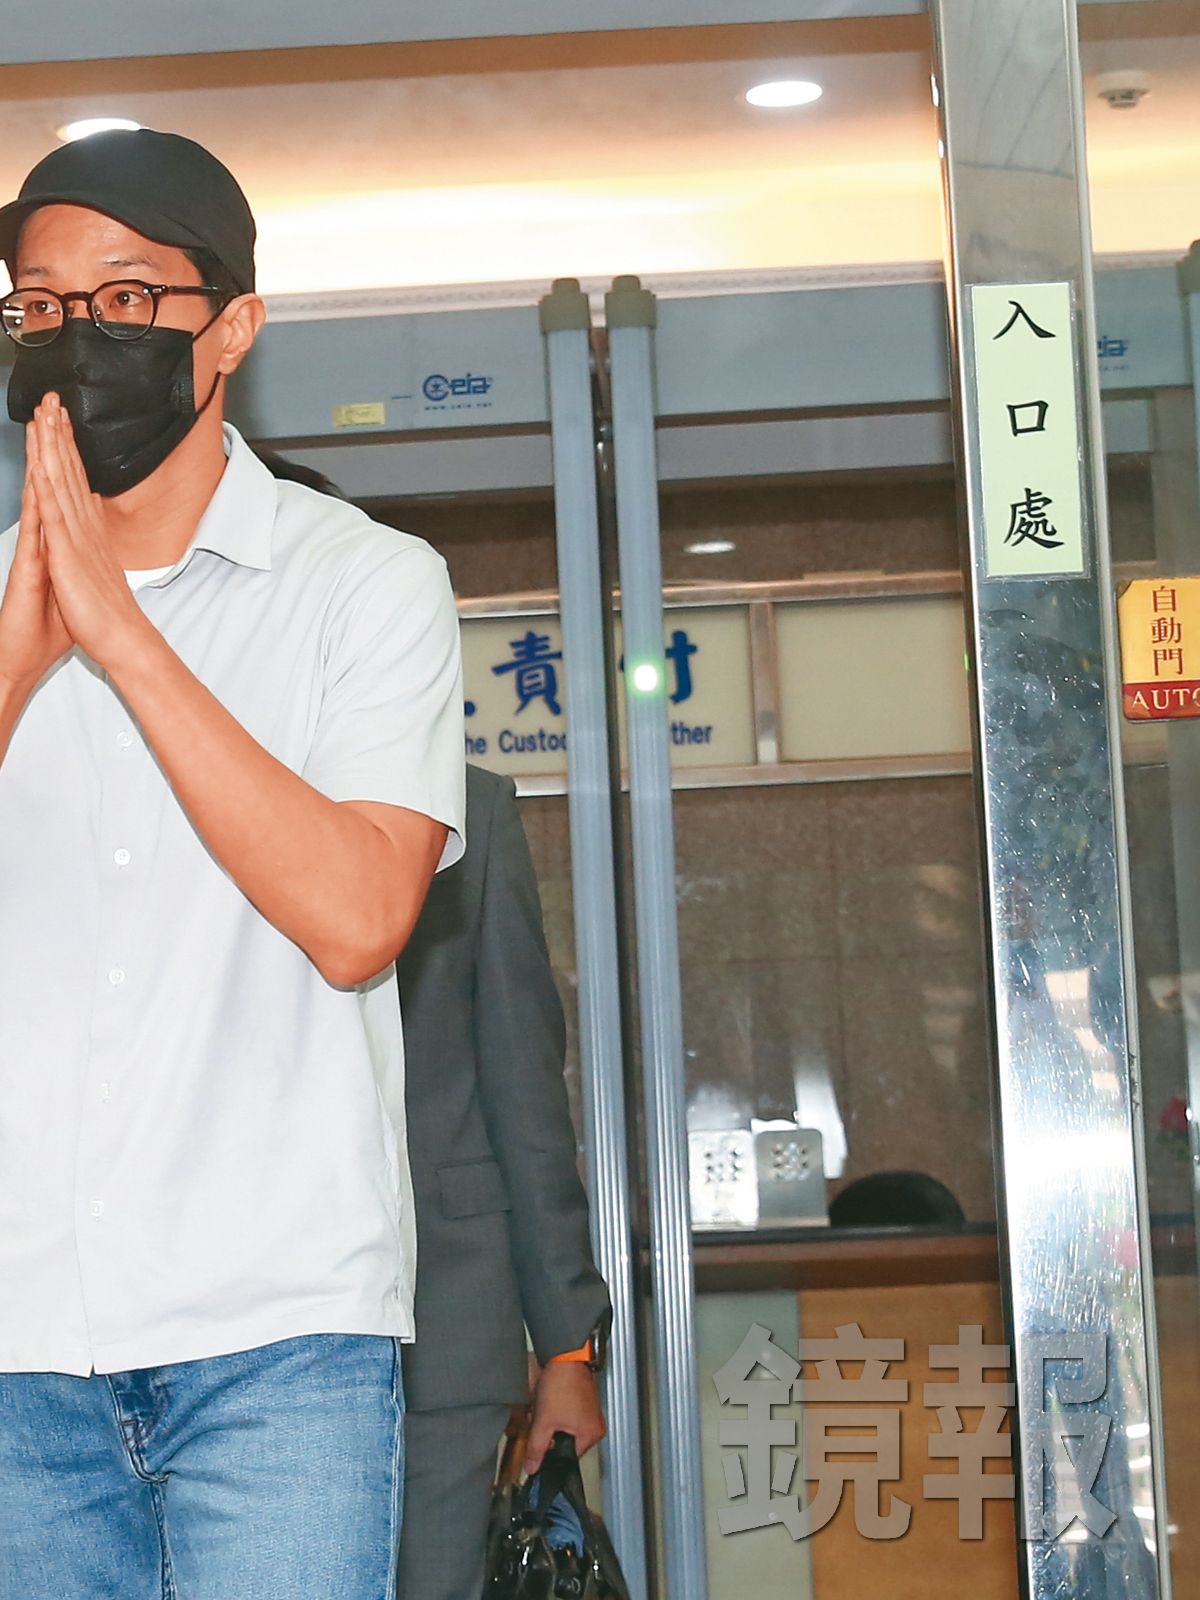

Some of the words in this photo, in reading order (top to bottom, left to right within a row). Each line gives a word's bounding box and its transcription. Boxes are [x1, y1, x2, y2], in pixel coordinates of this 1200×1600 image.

[992, 300, 1065, 549] 入口處
[1151, 585, 1184, 676] 自動門
